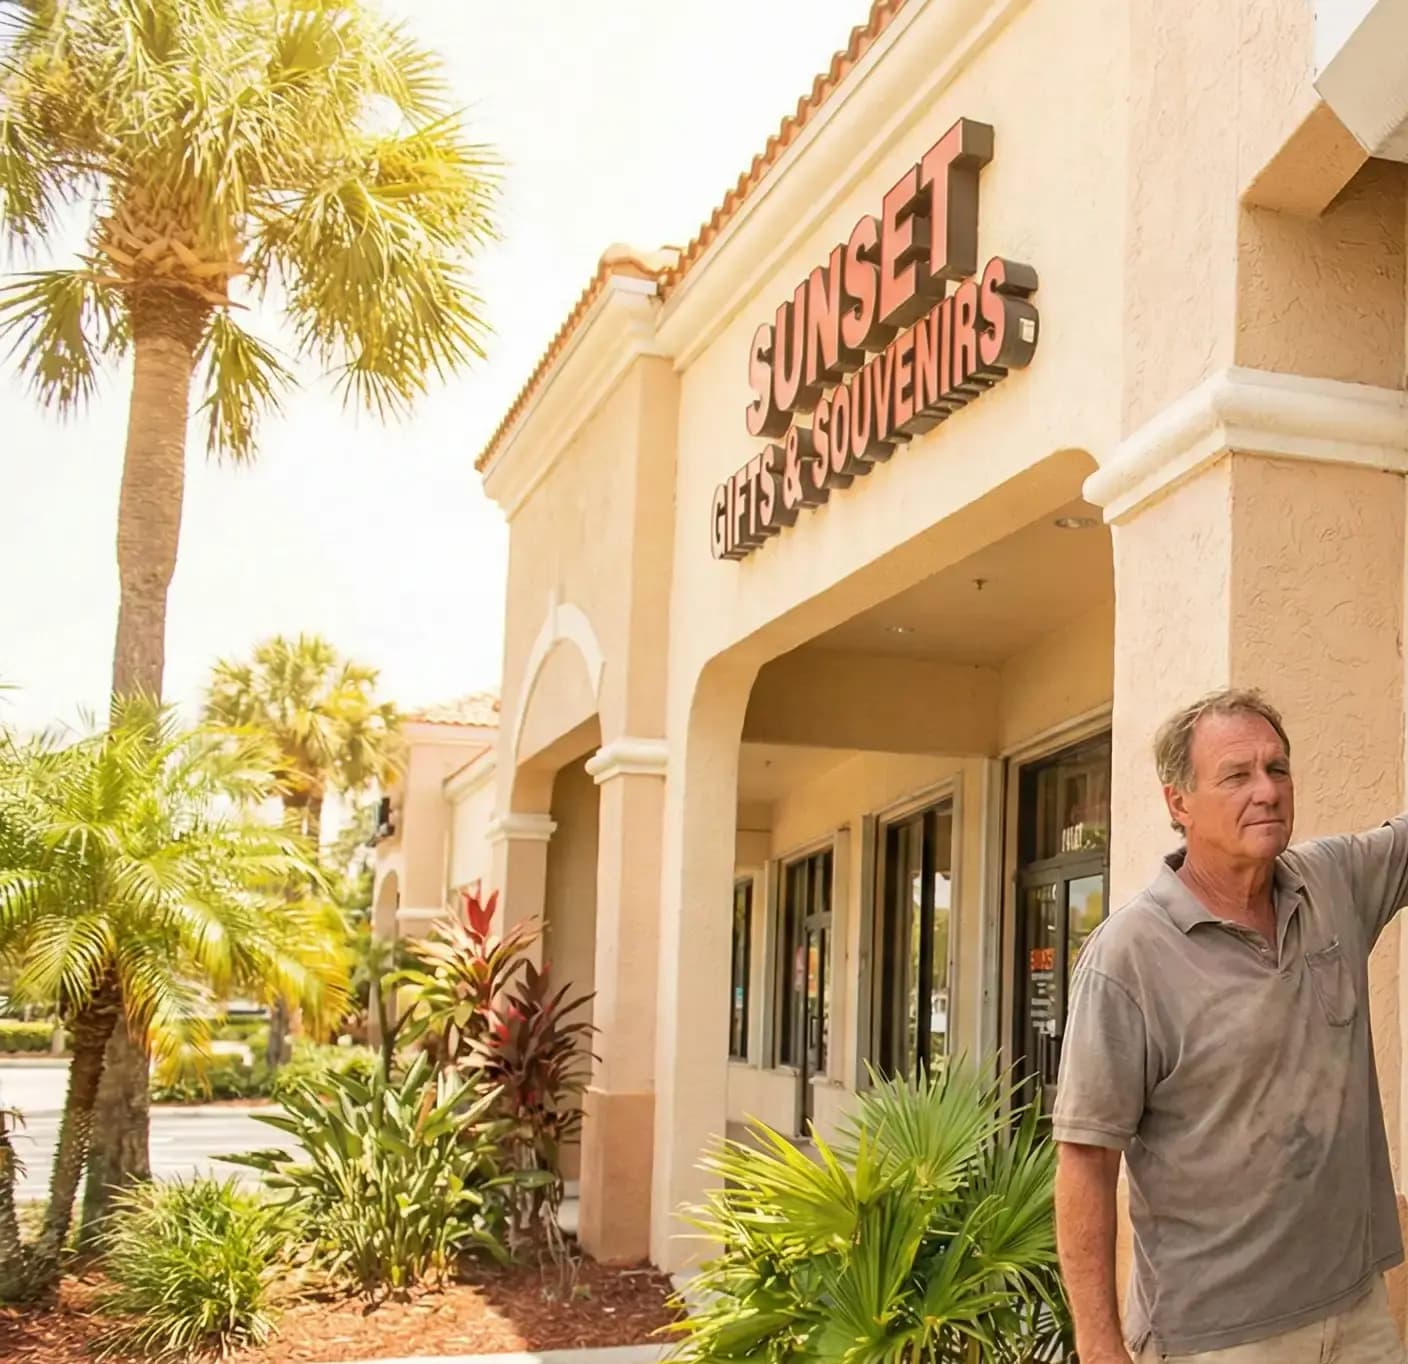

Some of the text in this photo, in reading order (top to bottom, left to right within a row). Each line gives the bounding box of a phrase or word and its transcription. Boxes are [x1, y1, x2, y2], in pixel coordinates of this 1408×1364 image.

[711, 256, 1010, 560] GIFTS & SOUVENIRS
[745, 117, 966, 437] SUNSET
